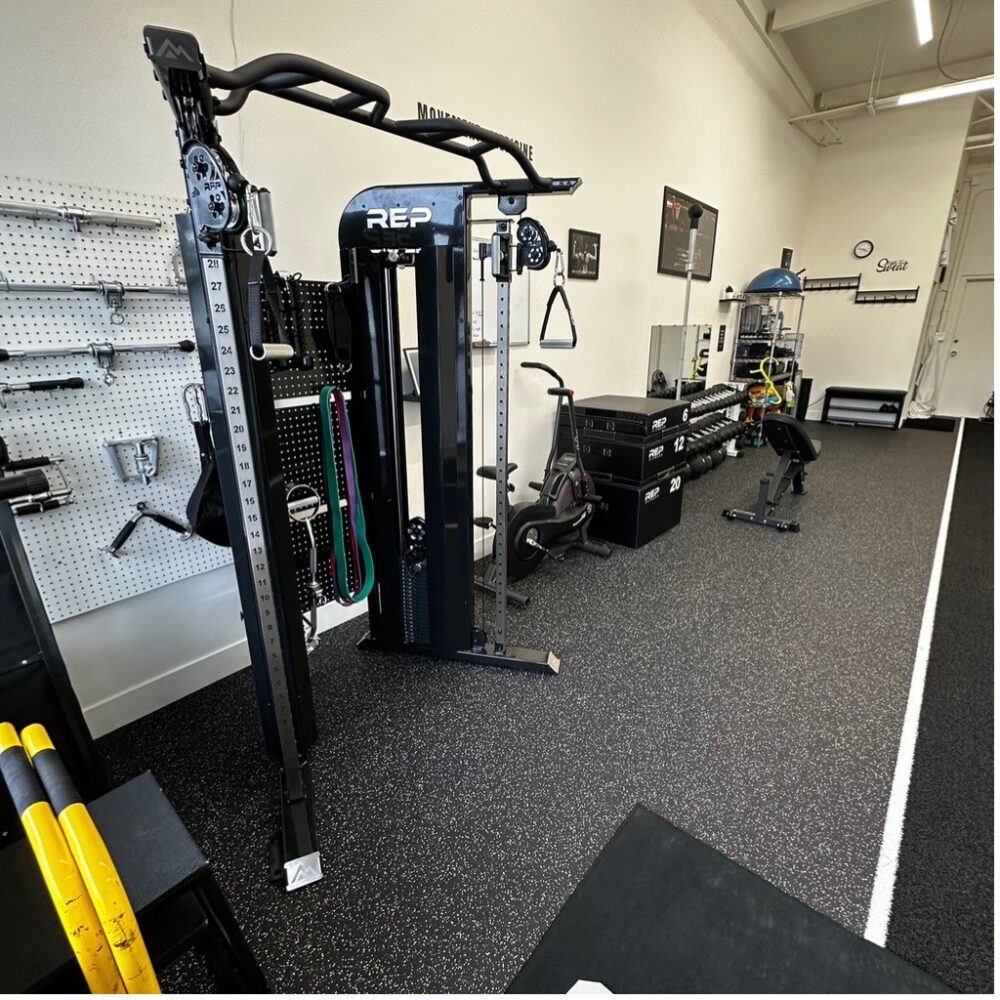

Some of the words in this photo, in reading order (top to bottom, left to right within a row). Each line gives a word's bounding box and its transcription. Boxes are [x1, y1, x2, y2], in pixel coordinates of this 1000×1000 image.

[366, 207, 432, 229] REP
[208, 259, 219, 268] 28
[211, 281, 222, 291] 27
[218, 325, 229, 334] 25
[221, 346, 233, 355] 24
[224, 366, 236, 376] 23
[227, 386, 239, 395] 22
[231, 406, 241, 414] 21
[682, 408, 689, 422] 6
[652, 416, 667, 430] REP
[233, 425, 244, 433] 20
[674, 435, 685, 453] 12
[648, 445, 664, 458] REP
[239, 462, 250, 470] 18
[242, 480, 252, 488] 17
[669, 476, 682, 493] 20
[644, 487, 660, 501] REP
[247, 514, 258, 522] 15
[255, 563, 265, 571] 12
